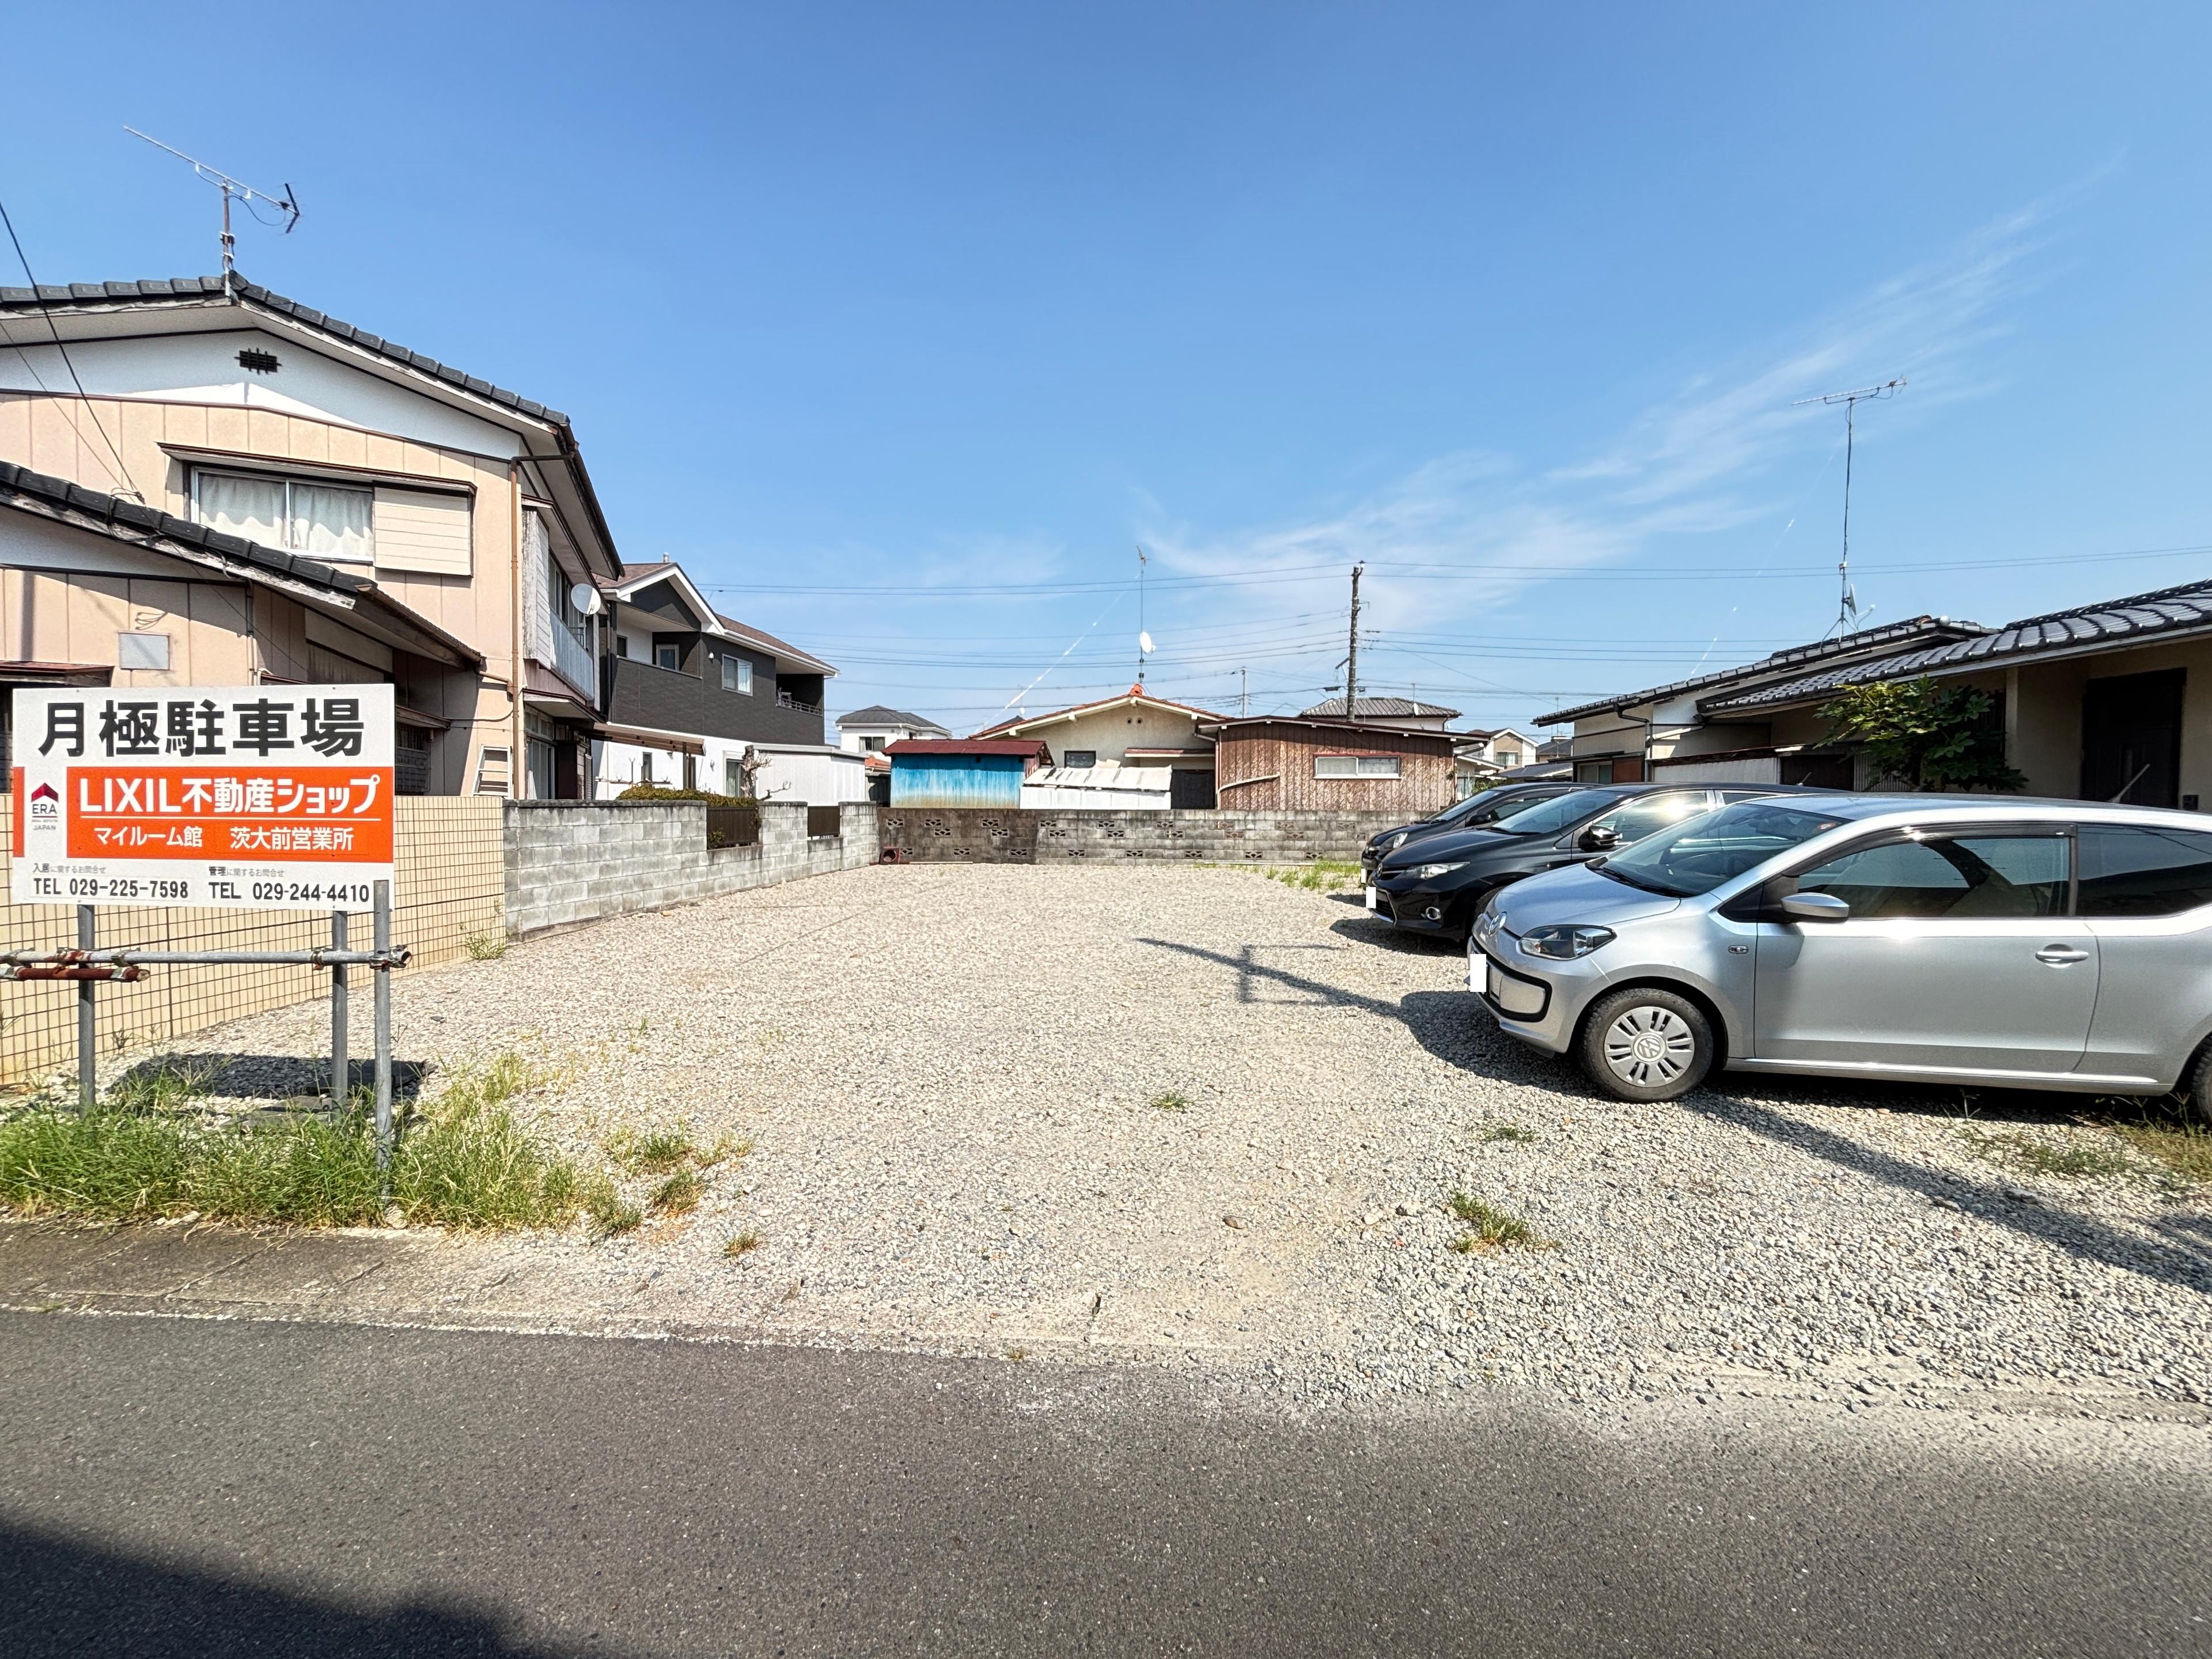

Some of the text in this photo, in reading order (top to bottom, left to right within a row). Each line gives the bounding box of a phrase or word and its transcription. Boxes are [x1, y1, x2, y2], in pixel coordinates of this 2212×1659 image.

[38, 698, 364, 757] 月極駐車場
[79, 774, 381, 814] LIXIL不動産ショップ
[32, 804, 58, 815] ERA
[94, 825, 354, 851] マイルーム館 茨大前営業所
[33, 878, 188, 899] TEL 029-225-7598
[209, 882, 369, 903] TEL 029-244-4410
